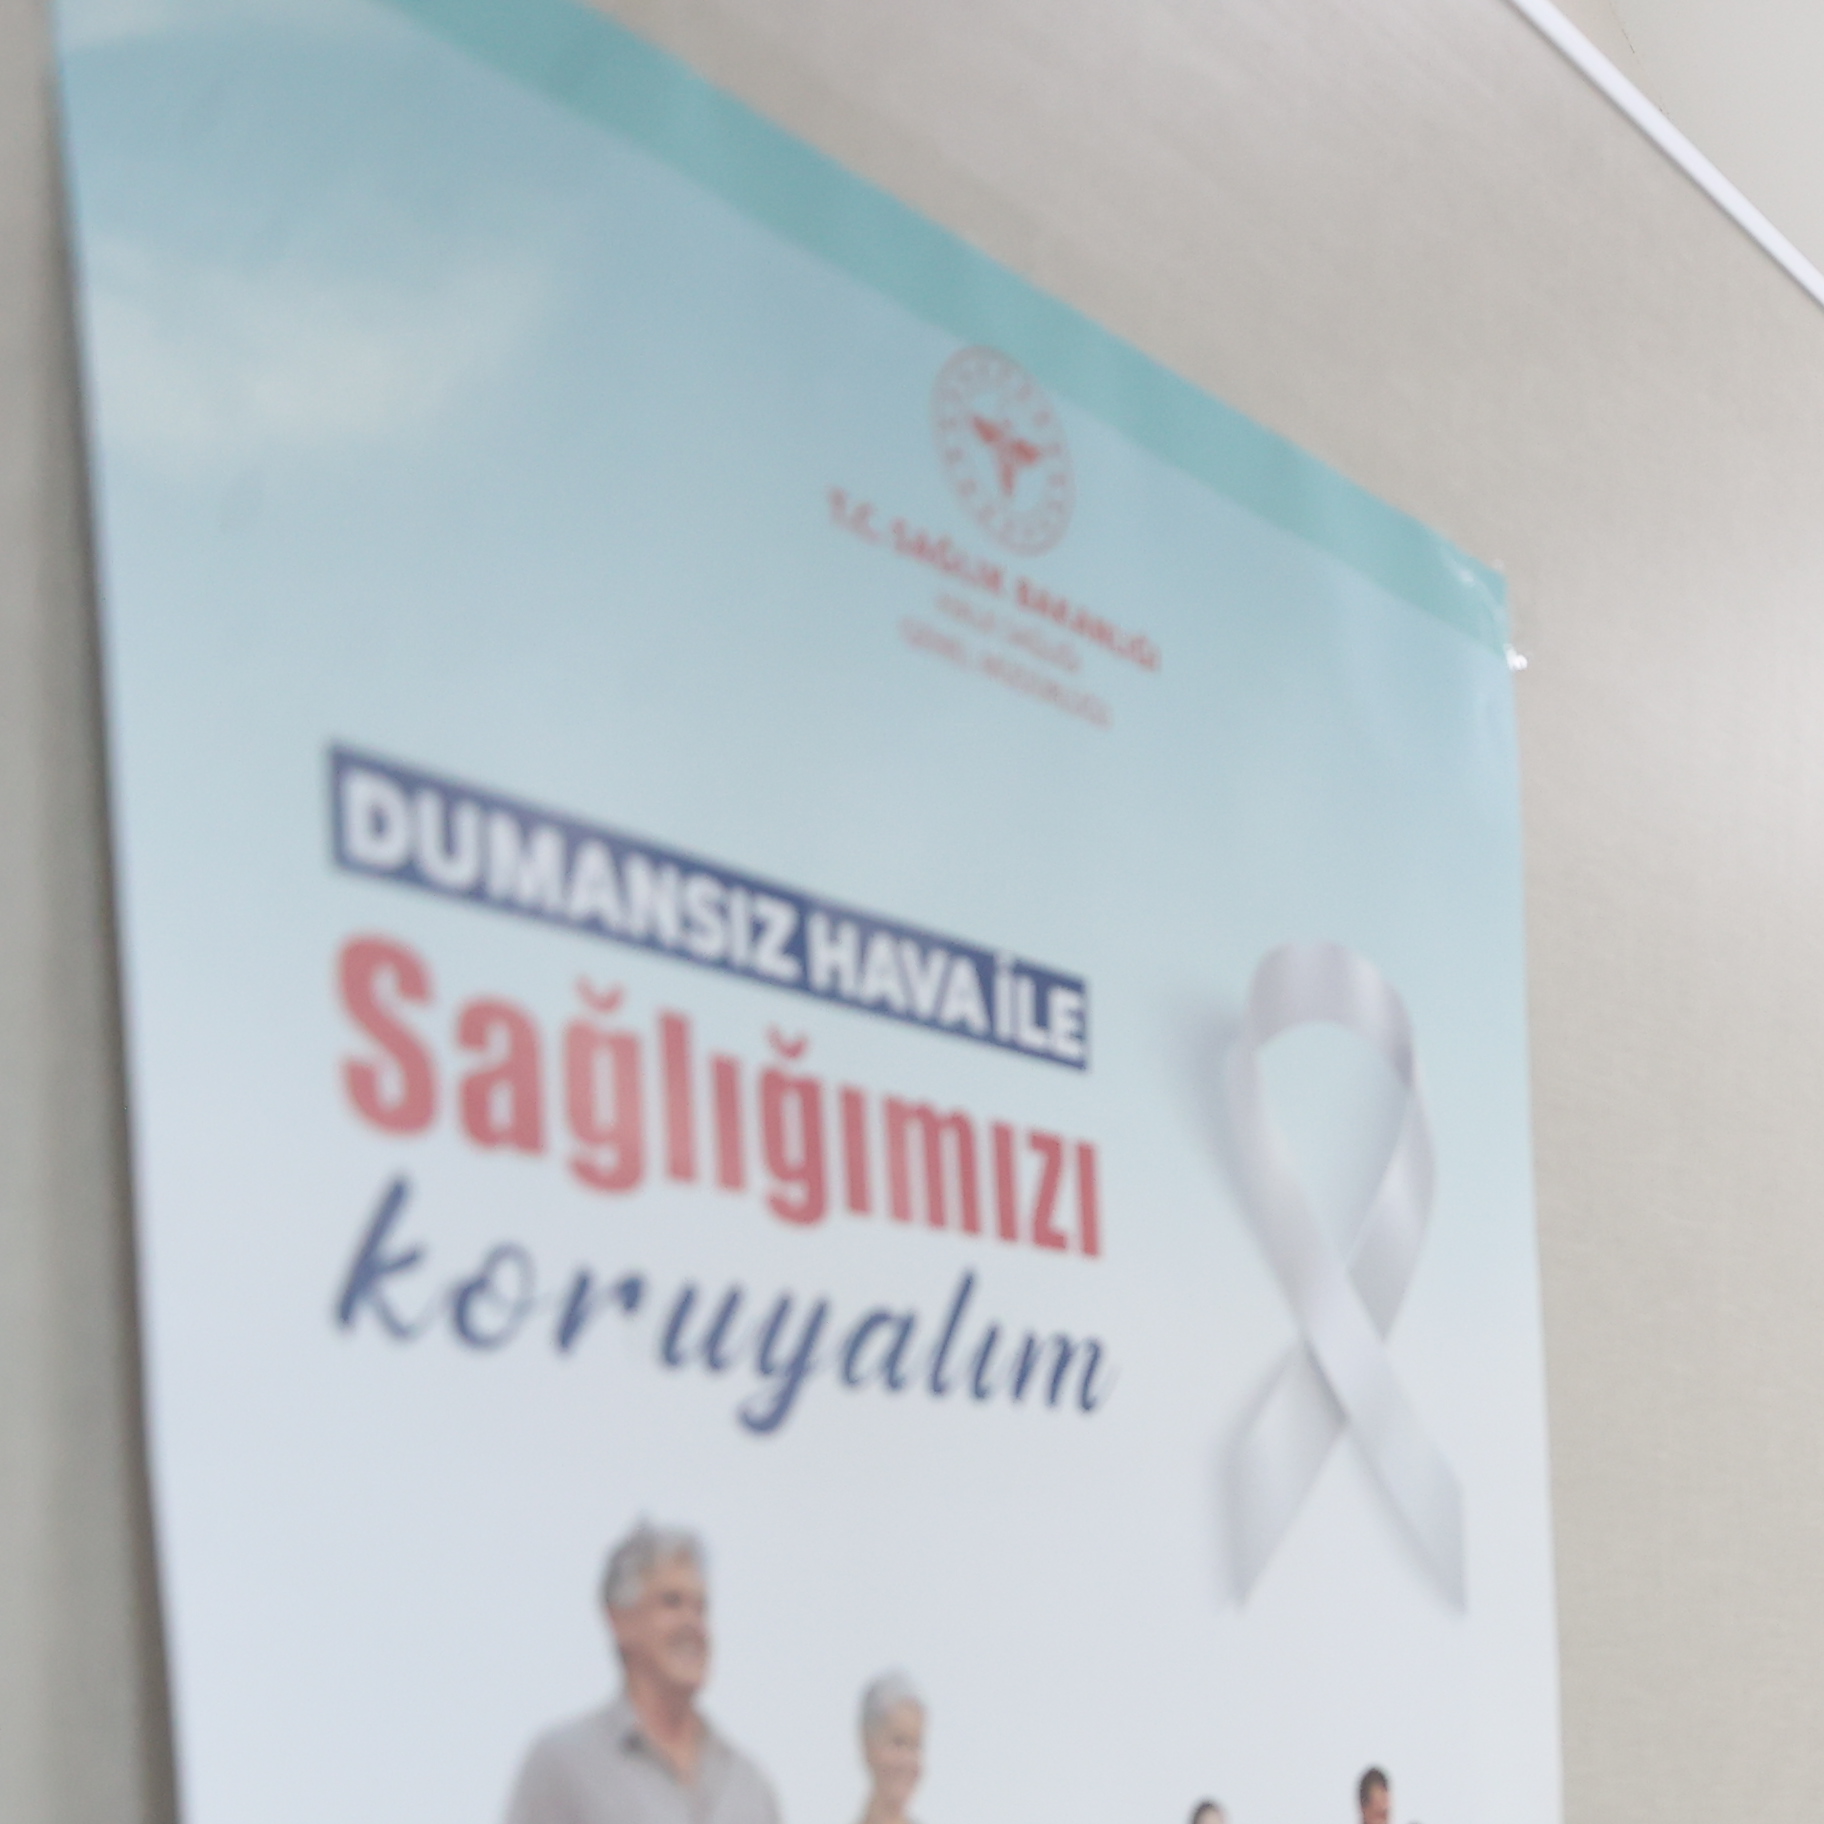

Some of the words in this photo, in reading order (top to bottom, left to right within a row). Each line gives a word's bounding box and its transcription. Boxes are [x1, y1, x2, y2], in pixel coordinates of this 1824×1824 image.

[338, 766, 801, 983] DUMANSIZ
[807, 912, 988, 1036] HAVA
[994, 952, 1087, 1060] İLE
[334, 932, 1103, 1260] Sağlığımızı
[332, 1174, 1112, 1436] koruyalım
